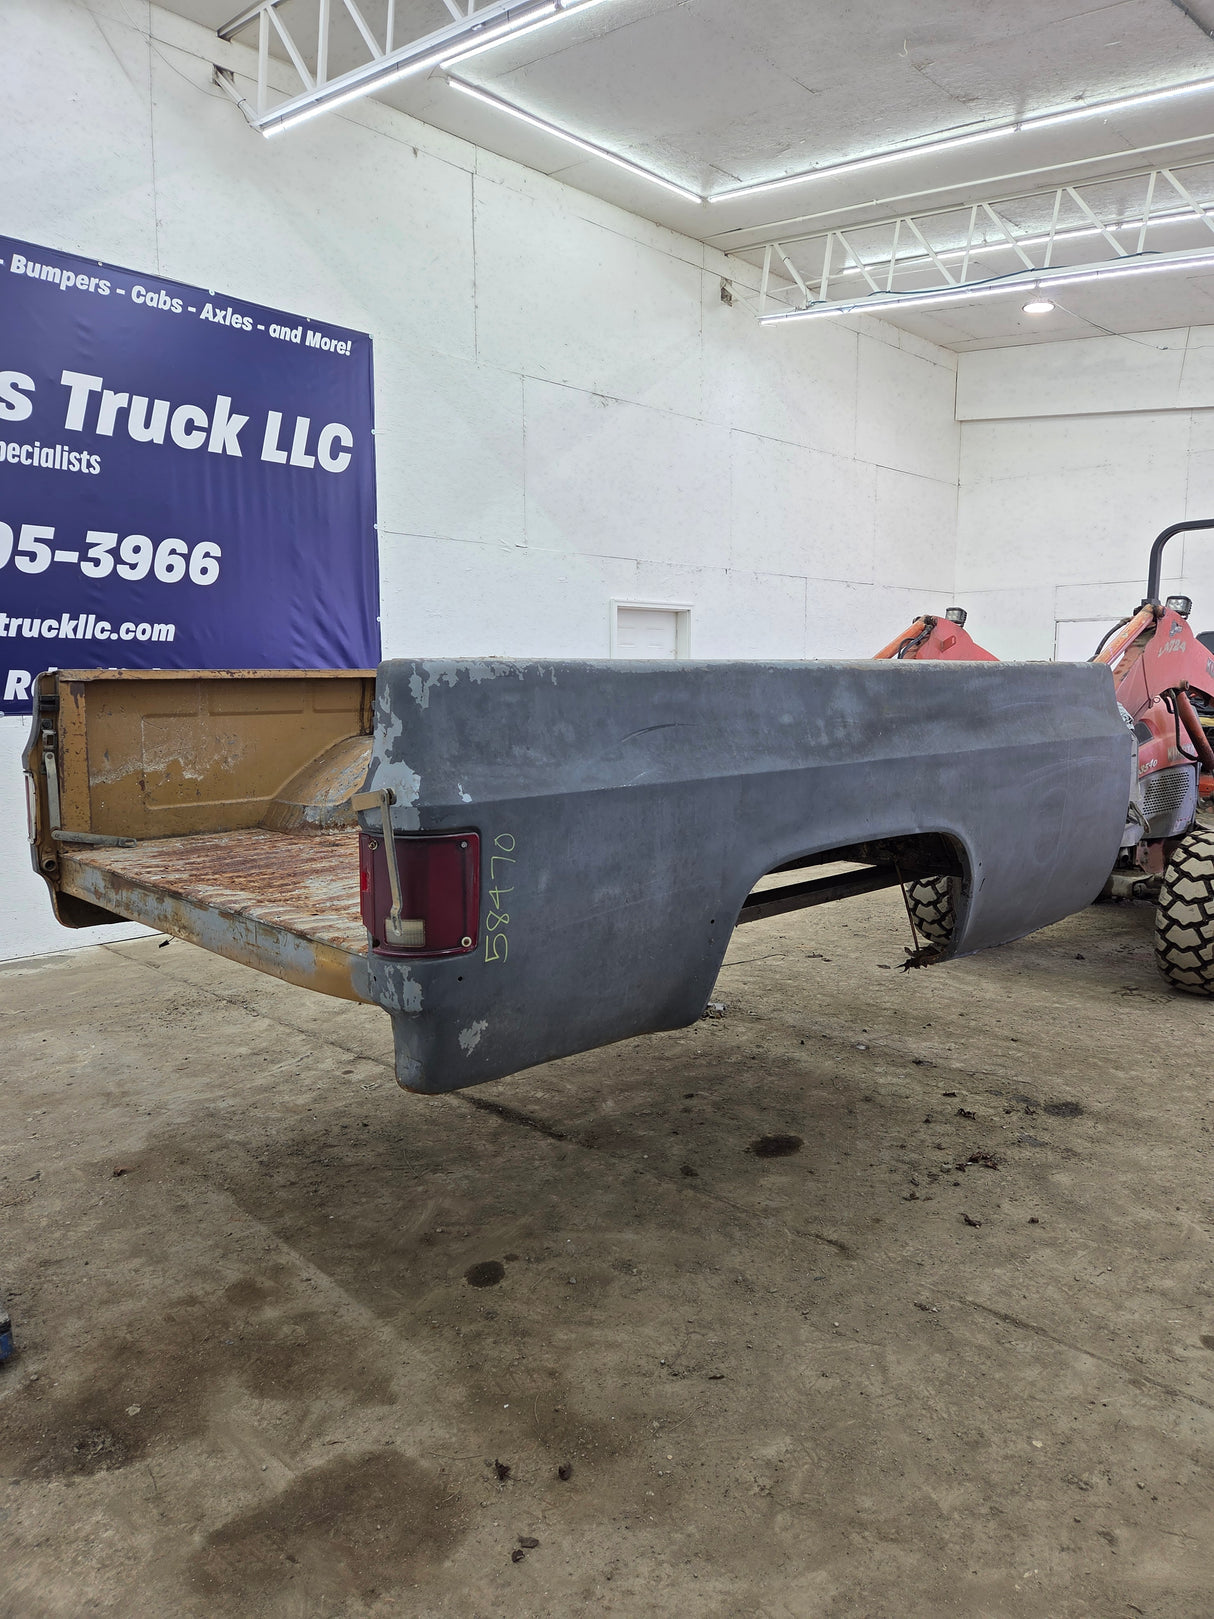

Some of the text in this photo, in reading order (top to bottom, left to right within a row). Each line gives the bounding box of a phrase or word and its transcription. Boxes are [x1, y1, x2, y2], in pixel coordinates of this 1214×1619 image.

[10, 253, 111, 296] Bumpers
[131, 285, 183, 314] Cabs
[200, 302, 253, 331] Axles
[269, 323, 303, 344] and
[305, 330, 352, 356] More!
[60, 369, 250, 458] Truck
[260, 410, 354, 473] LLC
[484, 833, 516, 963] 58470
